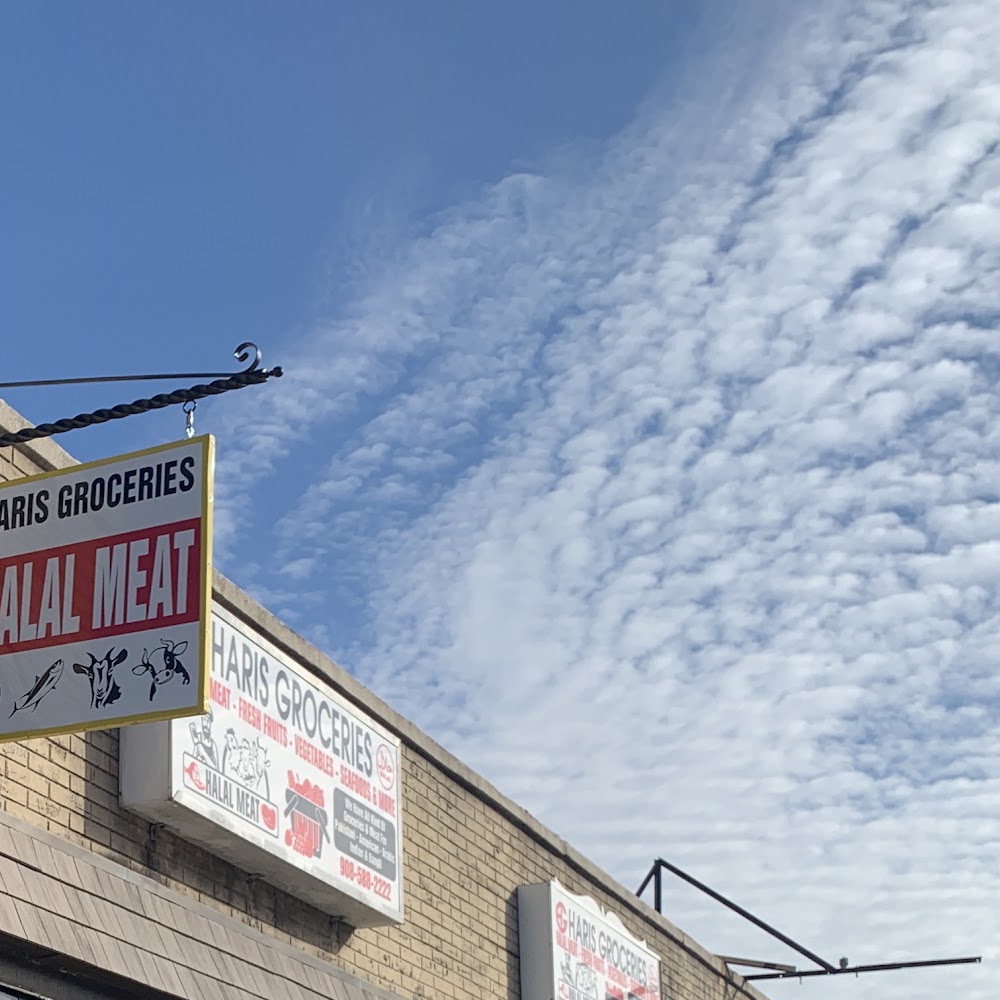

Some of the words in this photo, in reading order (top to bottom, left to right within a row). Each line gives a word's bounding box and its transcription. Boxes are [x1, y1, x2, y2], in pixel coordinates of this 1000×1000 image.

[57, 456, 195, 519] GROCERIES
[91, 528, 195, 630] MEAT
[212, 621, 269, 707] HARIS
[275, 670, 373, 777] GROCERIES
[210, 676, 231, 711] MEAT
[239, 697, 261, 730] FRESH
[263, 715, 289, 749] FRUITS
[294, 734, 334, 777] VEGETABLES
[340, 764, 371, 801] SEAFOODS
[205, 770, 235, 810] HALAL
[237, 789, 260, 824] MEAT
[340, 856, 391, 901] 908-588-2222
[568, 909, 596, 953] HARIS
[599, 931, 647, 987] GROCERIES
